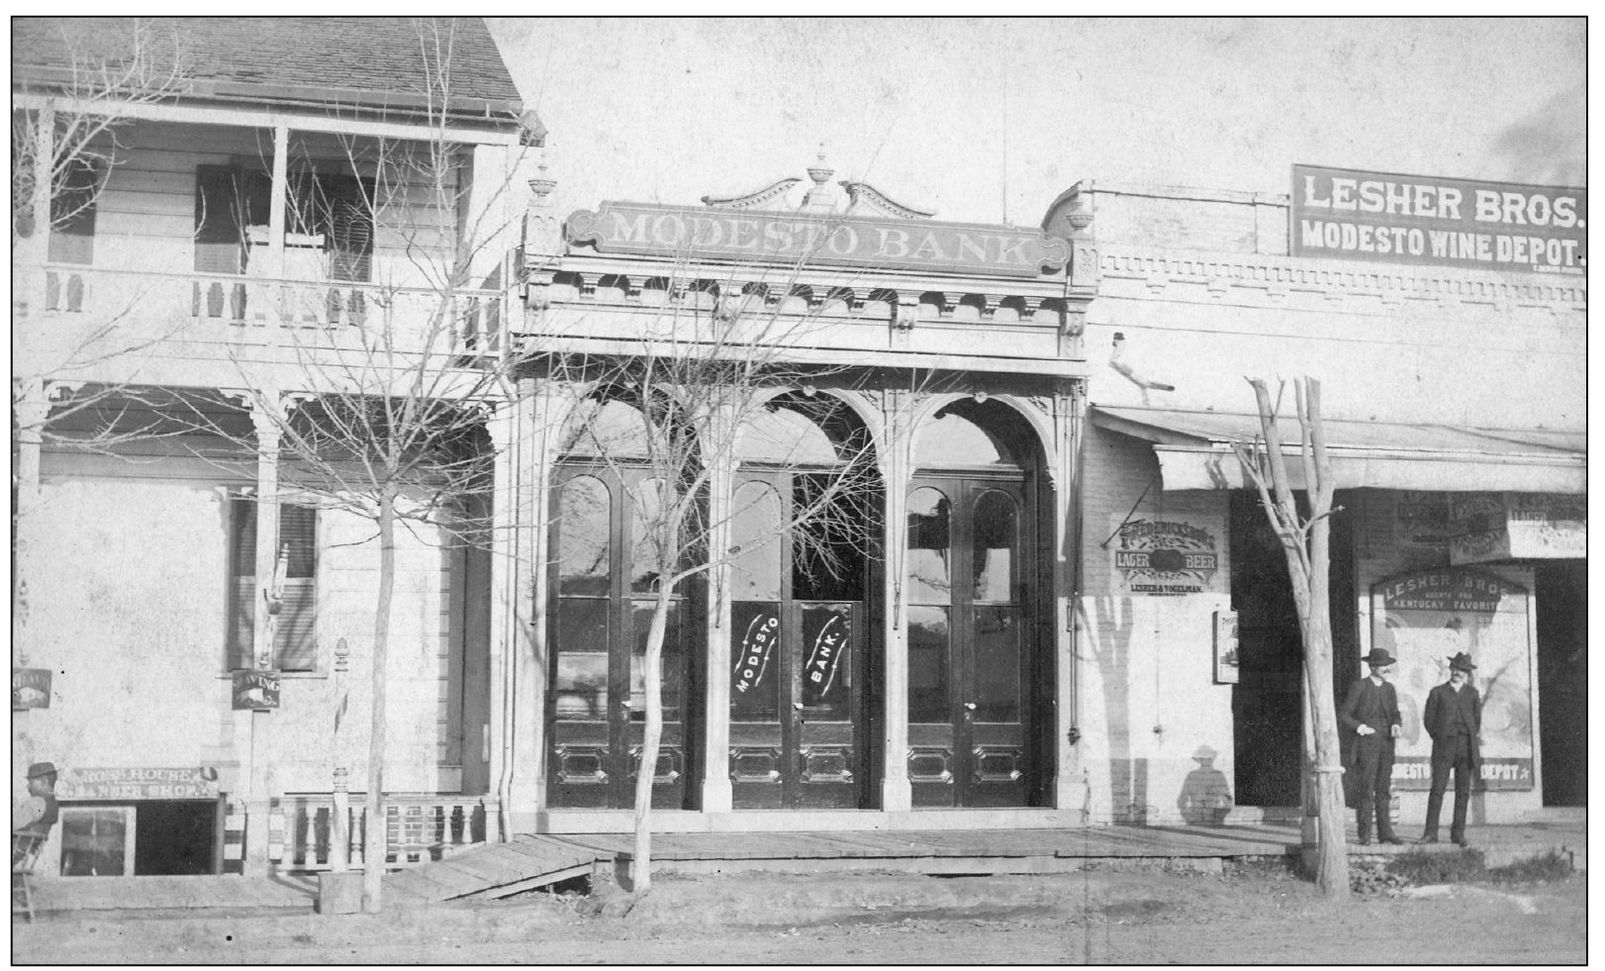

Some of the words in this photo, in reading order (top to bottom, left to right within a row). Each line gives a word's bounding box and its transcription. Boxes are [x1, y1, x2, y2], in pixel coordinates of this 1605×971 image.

[1304, 176, 1463, 220] LESHER
[1475, 190, 1586, 228] BROS.
[612, 214, 859, 255] MODESTO
[874, 228, 1035, 267] BANK
[1302, 219, 1425, 256] MODESTO
[1429, 230, 1492, 261] WINE
[1497, 236, 1587, 266] DEPOT.
[1117, 553, 1149, 567] LAGER
[1186, 555, 1215, 568] BEER
[1385, 575, 1450, 600] LESHER
[1394, 601, 1444, 609] KENTUCKY
[736, 617, 778, 692] MODESTO
[811, 632, 840, 683] BANK.
[1480, 764, 1519, 780] DEPOT
